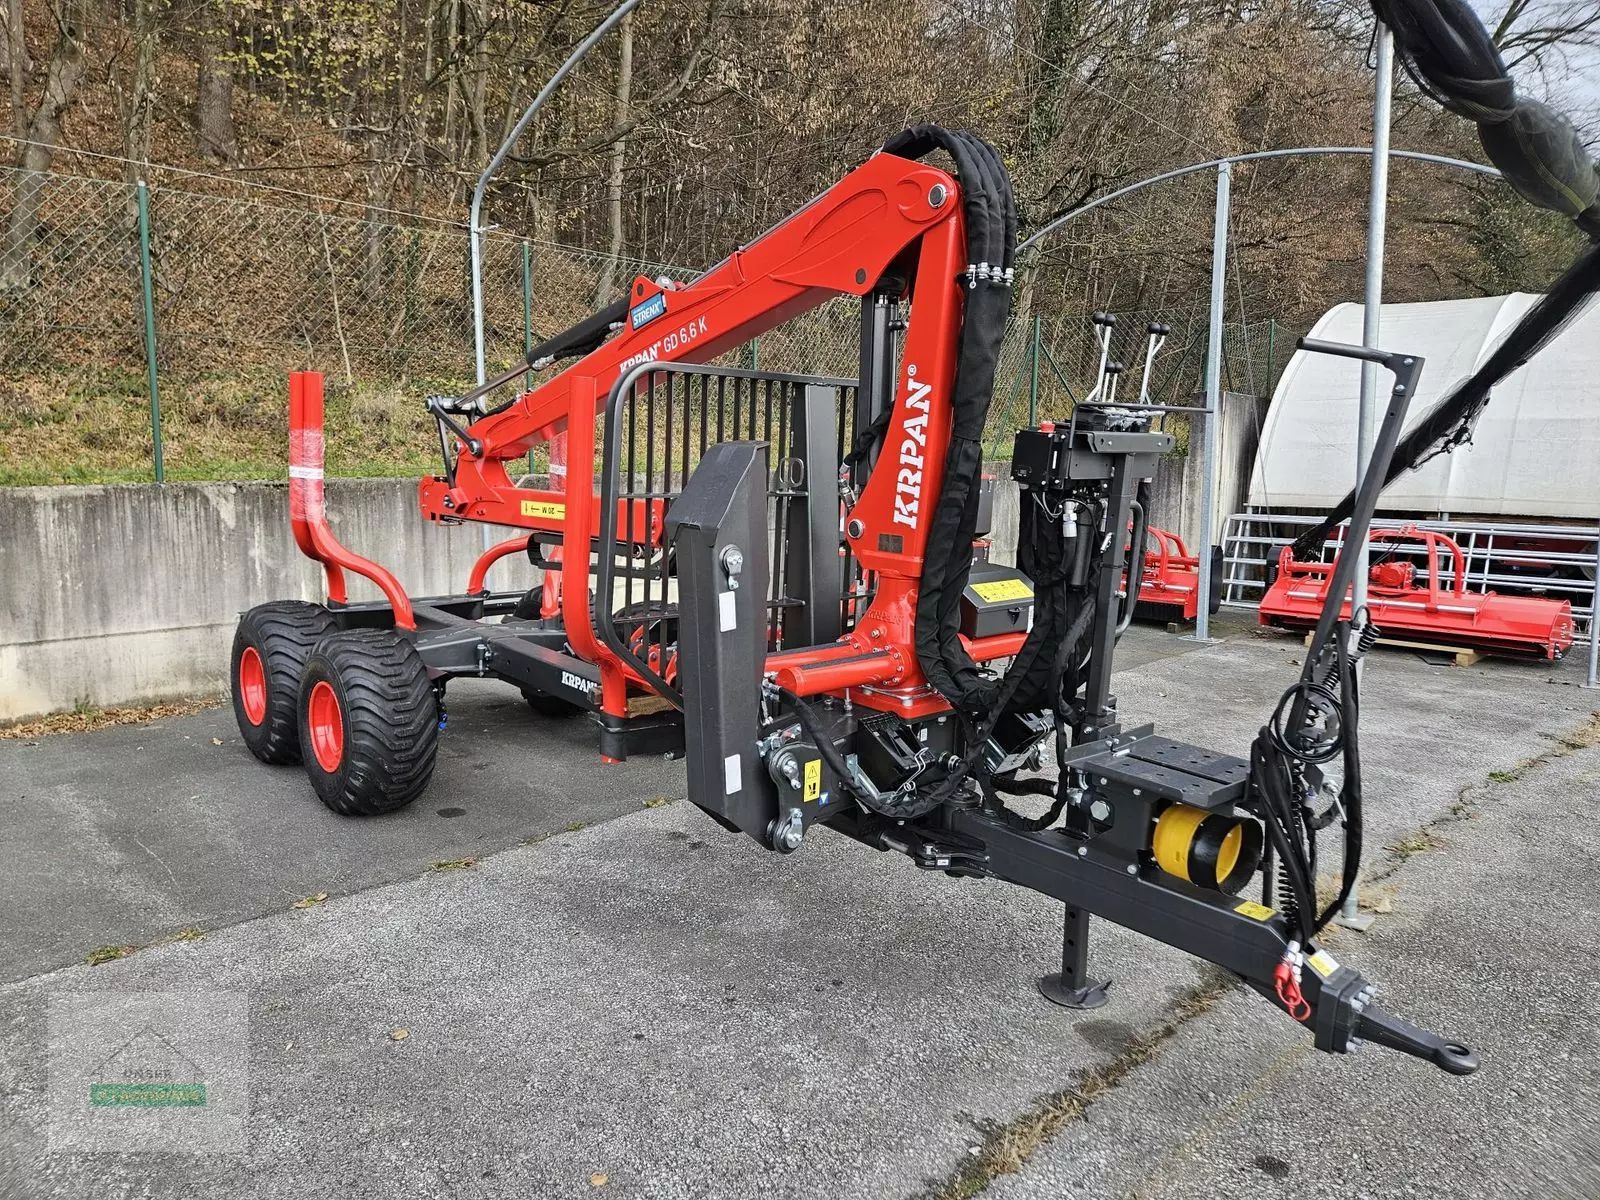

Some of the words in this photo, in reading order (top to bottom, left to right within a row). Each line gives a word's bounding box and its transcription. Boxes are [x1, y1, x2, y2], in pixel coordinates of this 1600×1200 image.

[663, 333, 678, 353] GD
[679, 322, 697, 344] 6,6
[698, 315, 708, 334] K
